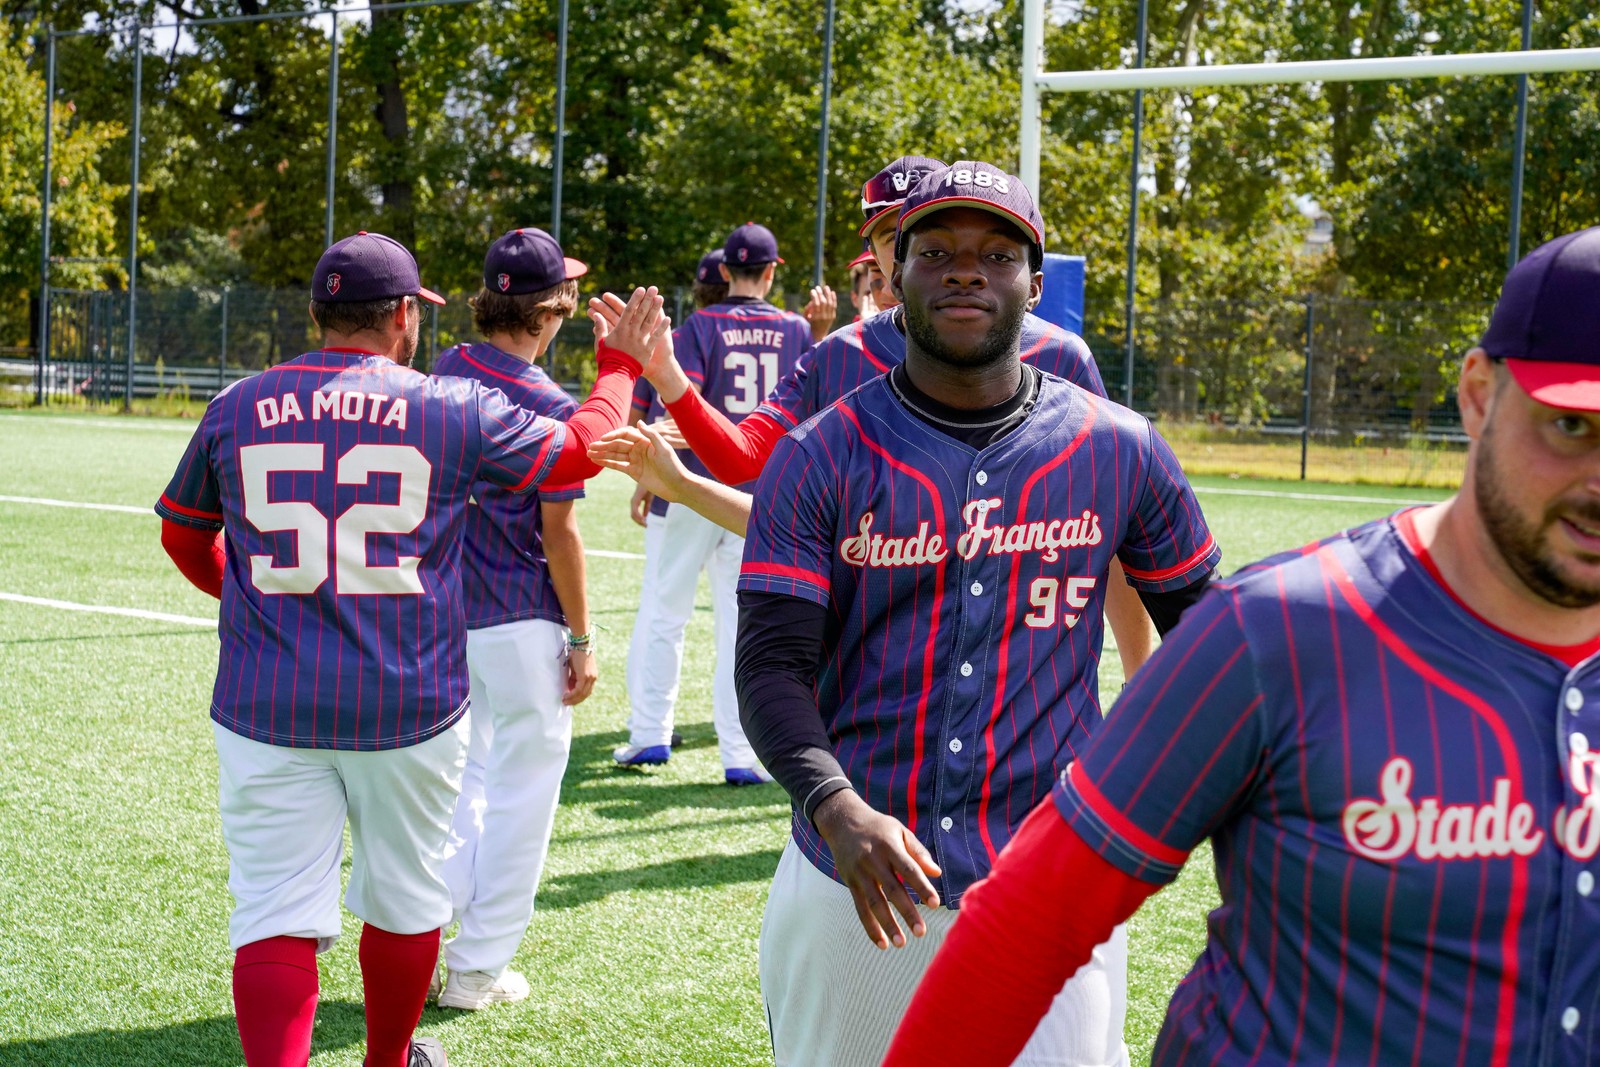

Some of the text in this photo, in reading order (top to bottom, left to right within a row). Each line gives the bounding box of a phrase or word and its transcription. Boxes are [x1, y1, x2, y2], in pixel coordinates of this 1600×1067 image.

[944, 169, 1009, 194] 1883
[722, 328, 784, 348] DUARTE
[256, 390, 408, 431] DA MOTA
[723, 351, 778, 414] 31
[239, 442, 432, 595] 52
[840, 498, 1103, 567] Stade Français
[1024, 576, 1096, 629] 95
[1342, 756, 1545, 861] Stade
